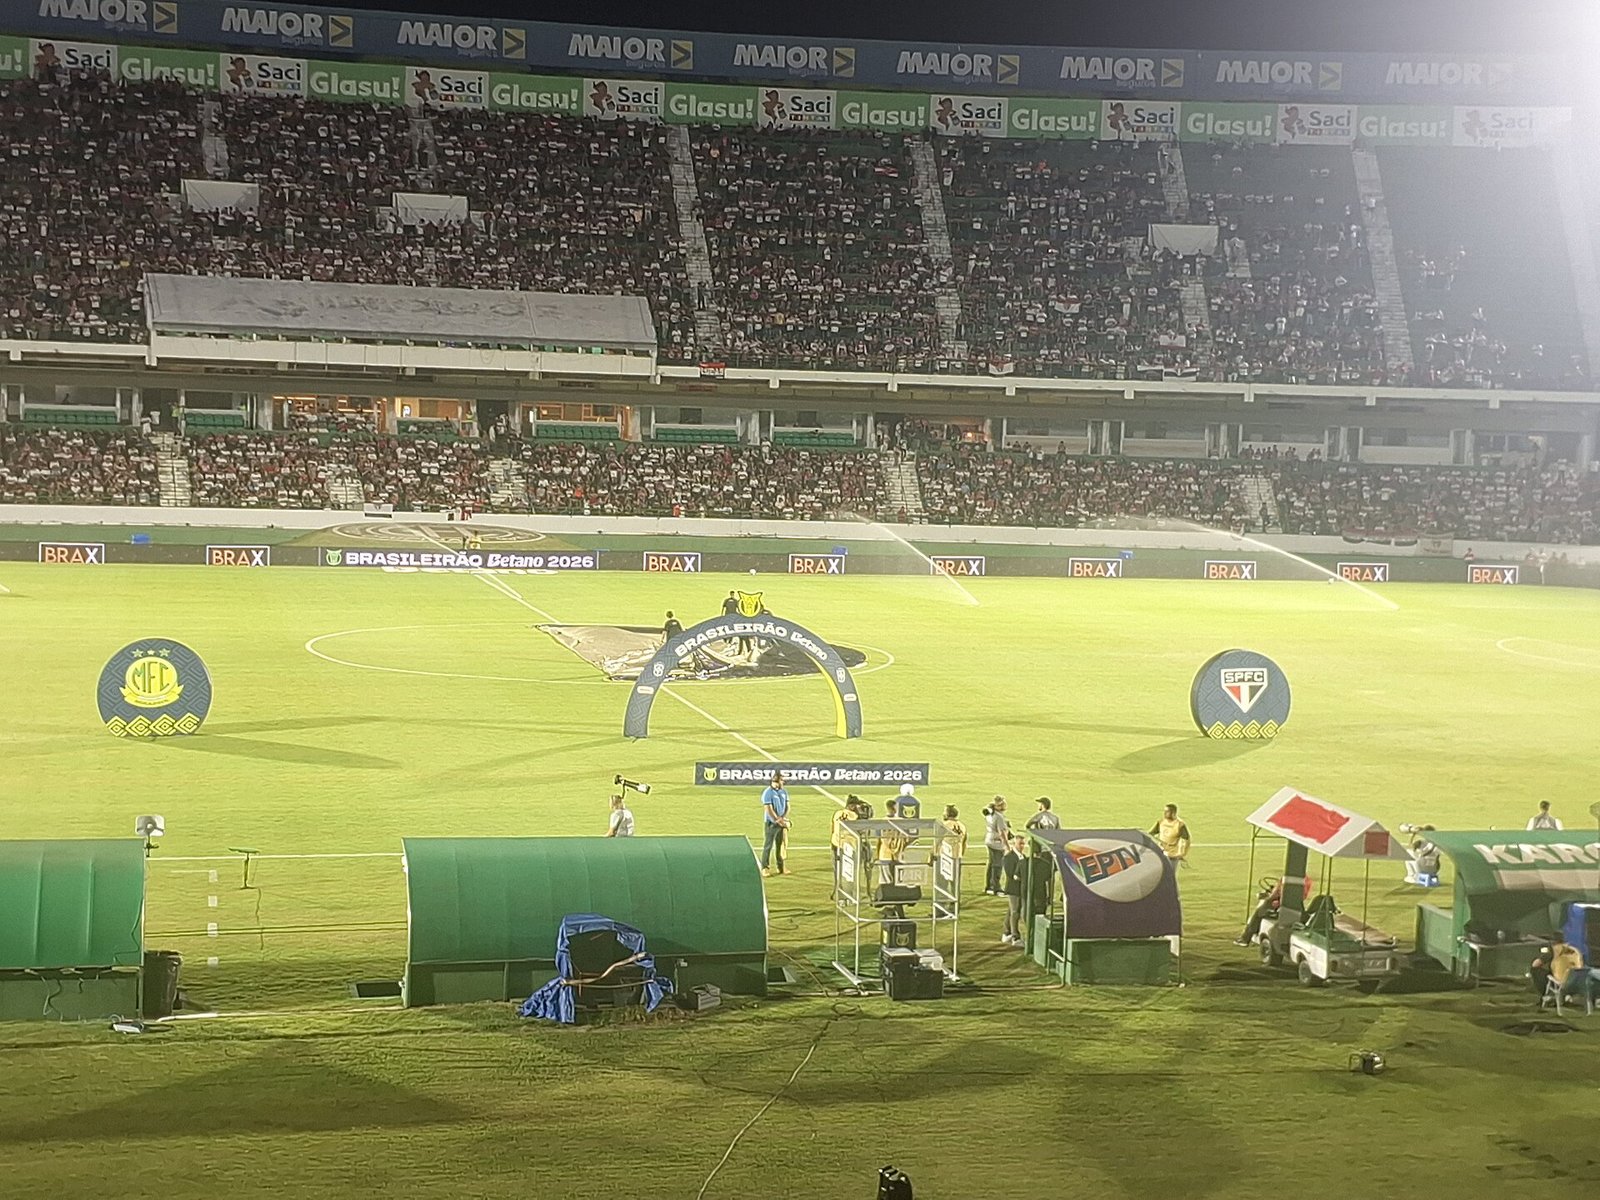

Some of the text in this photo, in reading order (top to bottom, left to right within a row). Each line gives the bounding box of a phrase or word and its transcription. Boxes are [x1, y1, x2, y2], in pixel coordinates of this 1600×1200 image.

[38, 0, 147, 23] MAIOR
[221, 8, 323, 38] MAIOR
[397, 20, 497, 50] MAIOR
[568, 33, 665, 62] MAIOR
[733, 44, 827, 69] MAIOR
[65, 48, 111, 67] Saci
[897, 51, 992, 76] MAIOR
[121, 57, 215, 86] Glasu!
[257, 62, 301, 80] Saci
[1060, 56, 1155, 80] MAIOR
[1216, 60, 1312, 84] MAIOR
[309, 71, 401, 98] Glasu!
[440, 75, 482, 94] Saci
[492, 84, 579, 110] Glasu!
[617, 86, 659, 104] Saci
[790, 96, 831, 113] Saci
[669, 94, 754, 119] Glasu!
[842, 102, 925, 127] Glasu!
[961, 103, 1002, 119] Saci
[1133, 107, 1174, 124] Saci
[1011, 108, 1097, 132] Glasu!
[1187, 112, 1272, 137] Glasu!
[1309, 110, 1351, 127] Saci
[1359, 115, 1448, 137] Glasu!
[45, 546, 99, 564] BRAX
[212, 549, 265, 567] BRAX
[345, 551, 594, 568] BRASILEIRÃO Betano 2026
[648, 555, 696, 573] BRAX
[793, 558, 839, 574] BRAX
[935, 560, 980, 576] BRAX
[1073, 562, 1117, 577] BRAX
[1208, 564, 1252, 579] BRAX
[1342, 566, 1384, 582] BRAX
[1472, 569, 1514, 584] BRAX
[674, 622, 828, 661] BRASILEIRÃO Betano
[131, 661, 170, 694] MFC
[1224, 671, 1264, 683] SPFC
[719, 766, 922, 781] BRASIEIRÃO Betano 2026
[1078, 844, 1142, 885] EPTV
